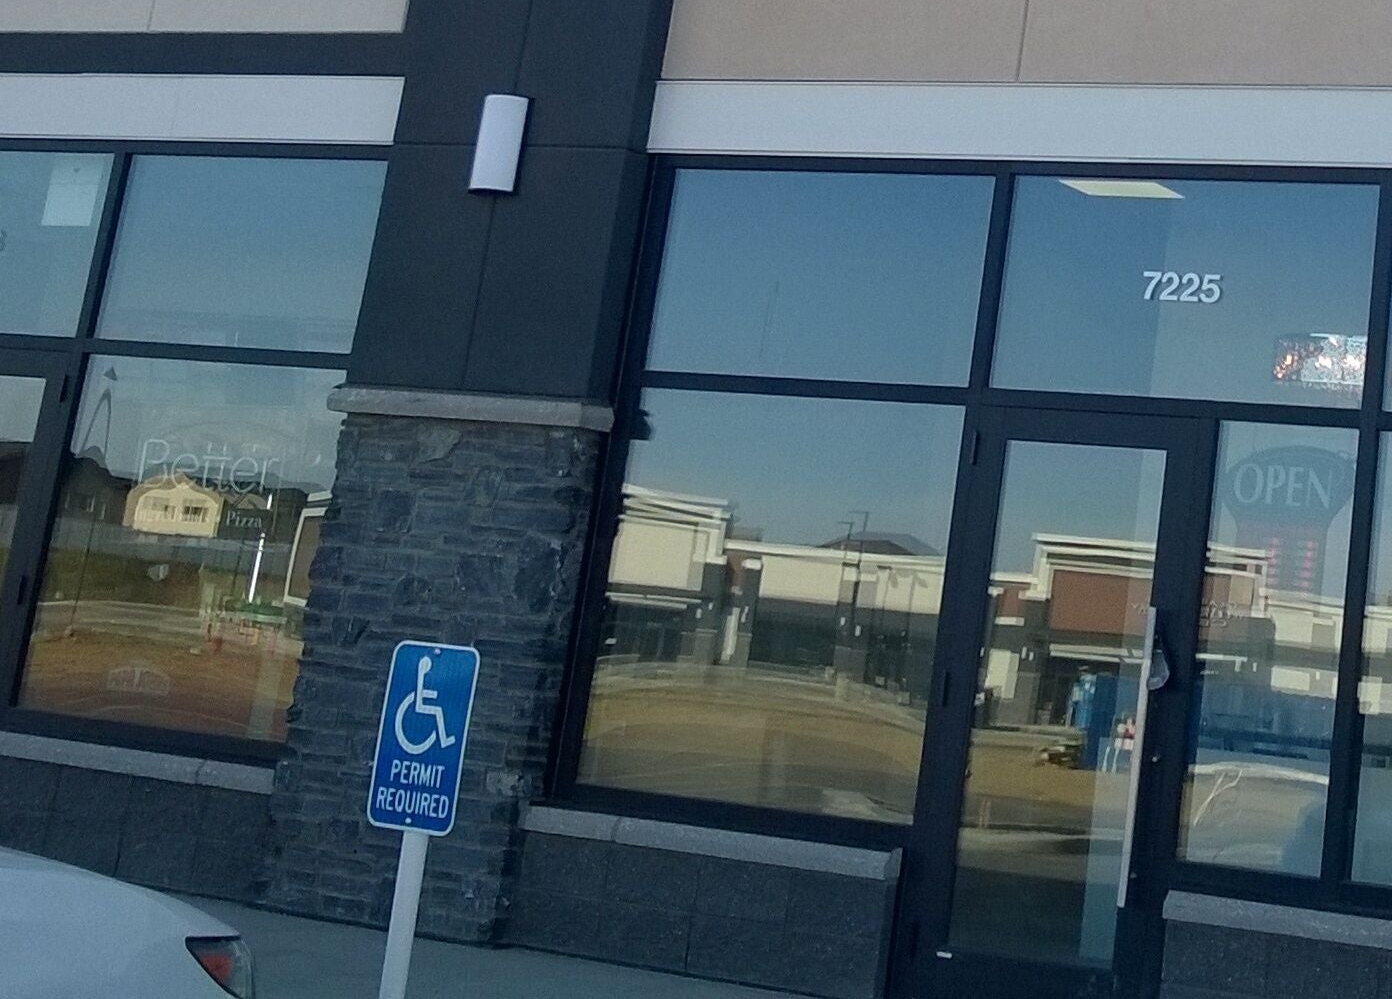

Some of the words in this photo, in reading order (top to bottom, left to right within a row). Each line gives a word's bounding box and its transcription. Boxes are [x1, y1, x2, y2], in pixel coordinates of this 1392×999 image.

[1143, 271, 1222, 304] 7225
[138, 438, 281, 494] Better
[1233, 463, 1334, 509] OPEN
[225, 509, 264, 529] Pizza
[390, 759, 446, 789] PERMIT
[376, 786, 450, 819] REQUIRED
